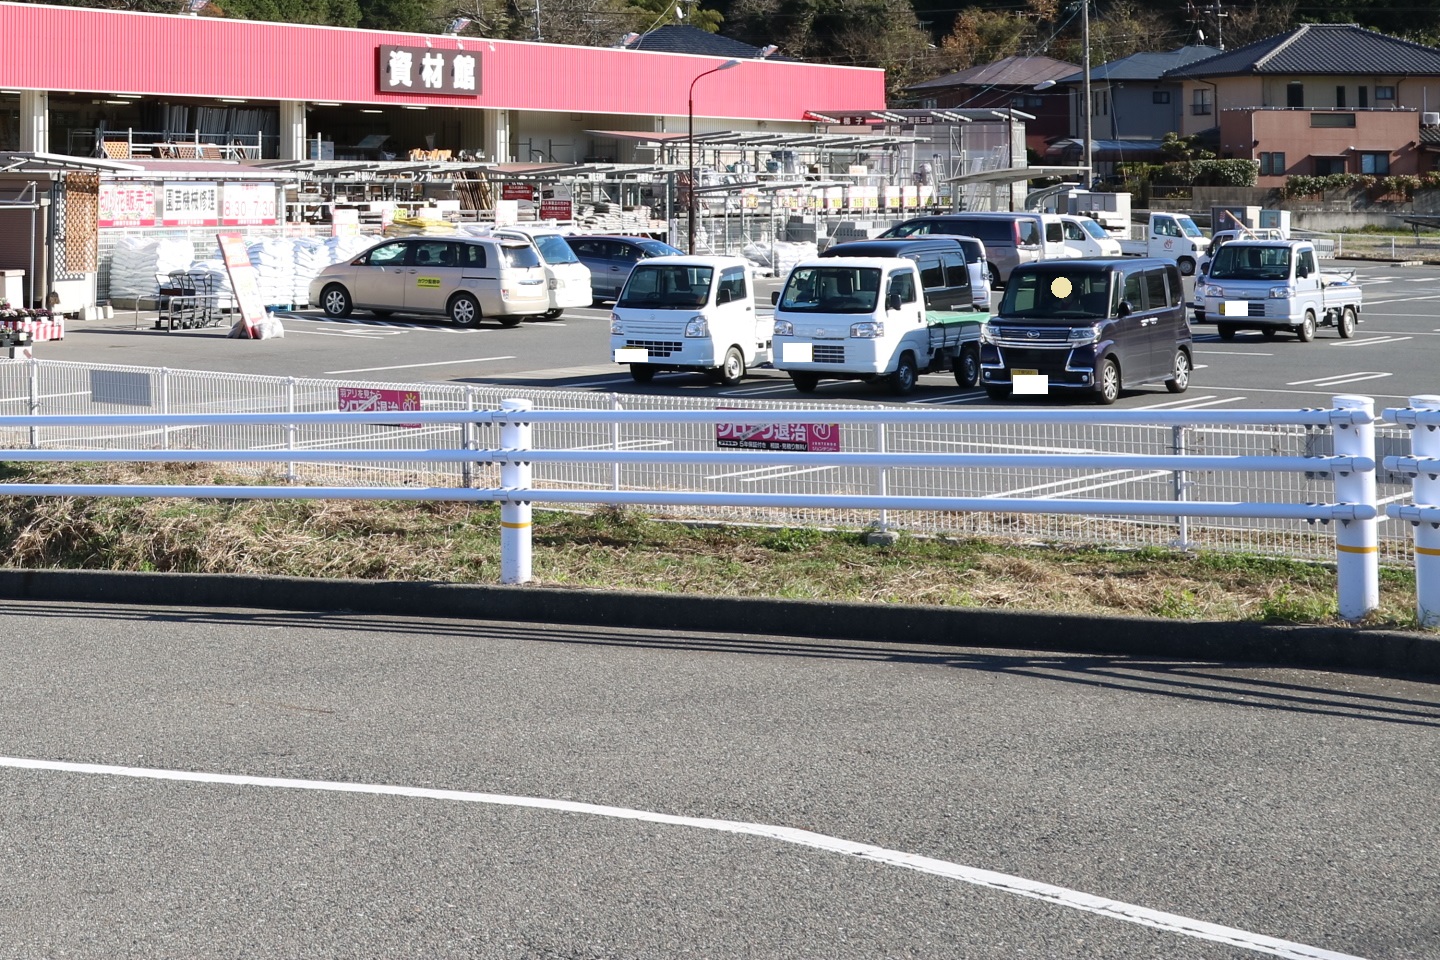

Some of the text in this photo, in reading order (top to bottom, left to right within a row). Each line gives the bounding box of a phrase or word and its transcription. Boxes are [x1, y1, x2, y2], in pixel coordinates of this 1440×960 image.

[389, 50, 476, 90] 資材館
[165, 189, 215, 211] 園芸機械修理
